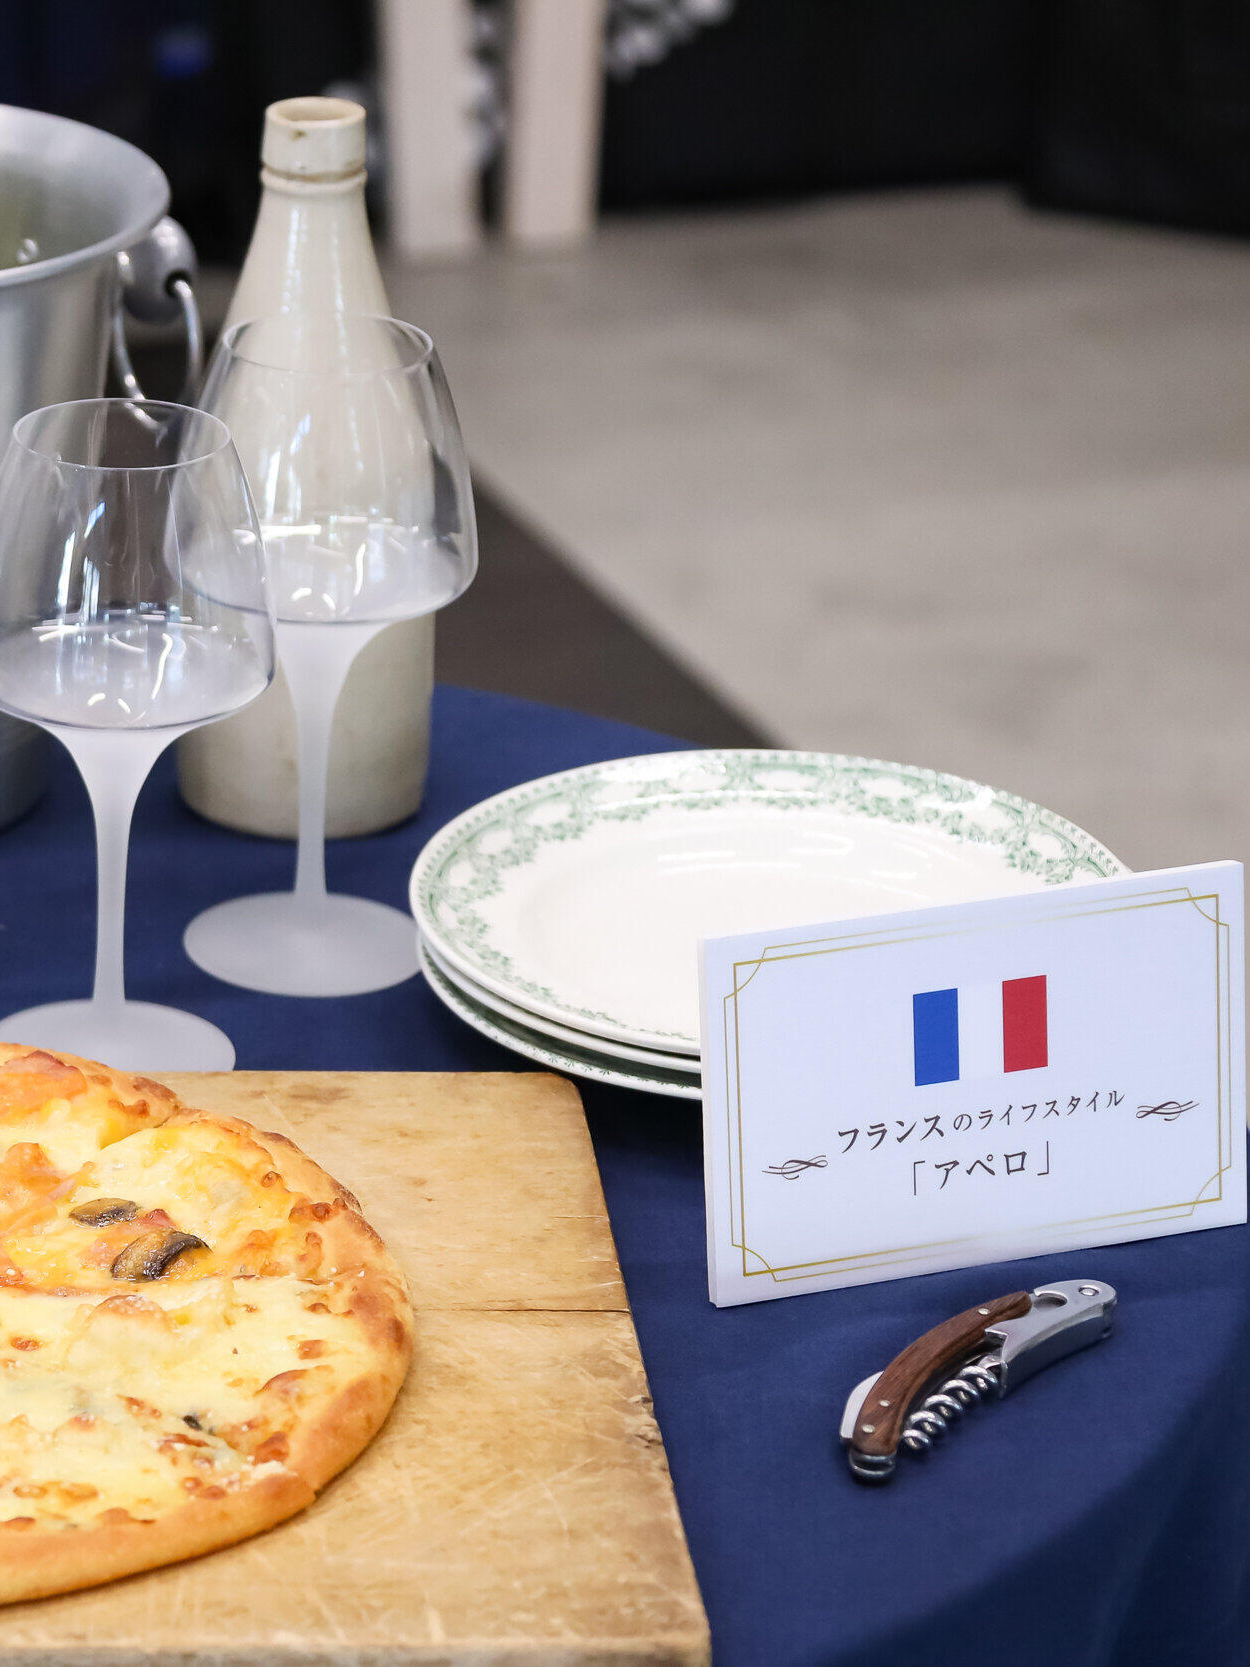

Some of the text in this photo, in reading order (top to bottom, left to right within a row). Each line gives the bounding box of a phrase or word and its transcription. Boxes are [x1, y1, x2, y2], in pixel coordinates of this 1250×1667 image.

[837, 1090, 1125, 1154] フランスのライフスタイル
[913, 1140, 1049, 1196] 「アペロ」
